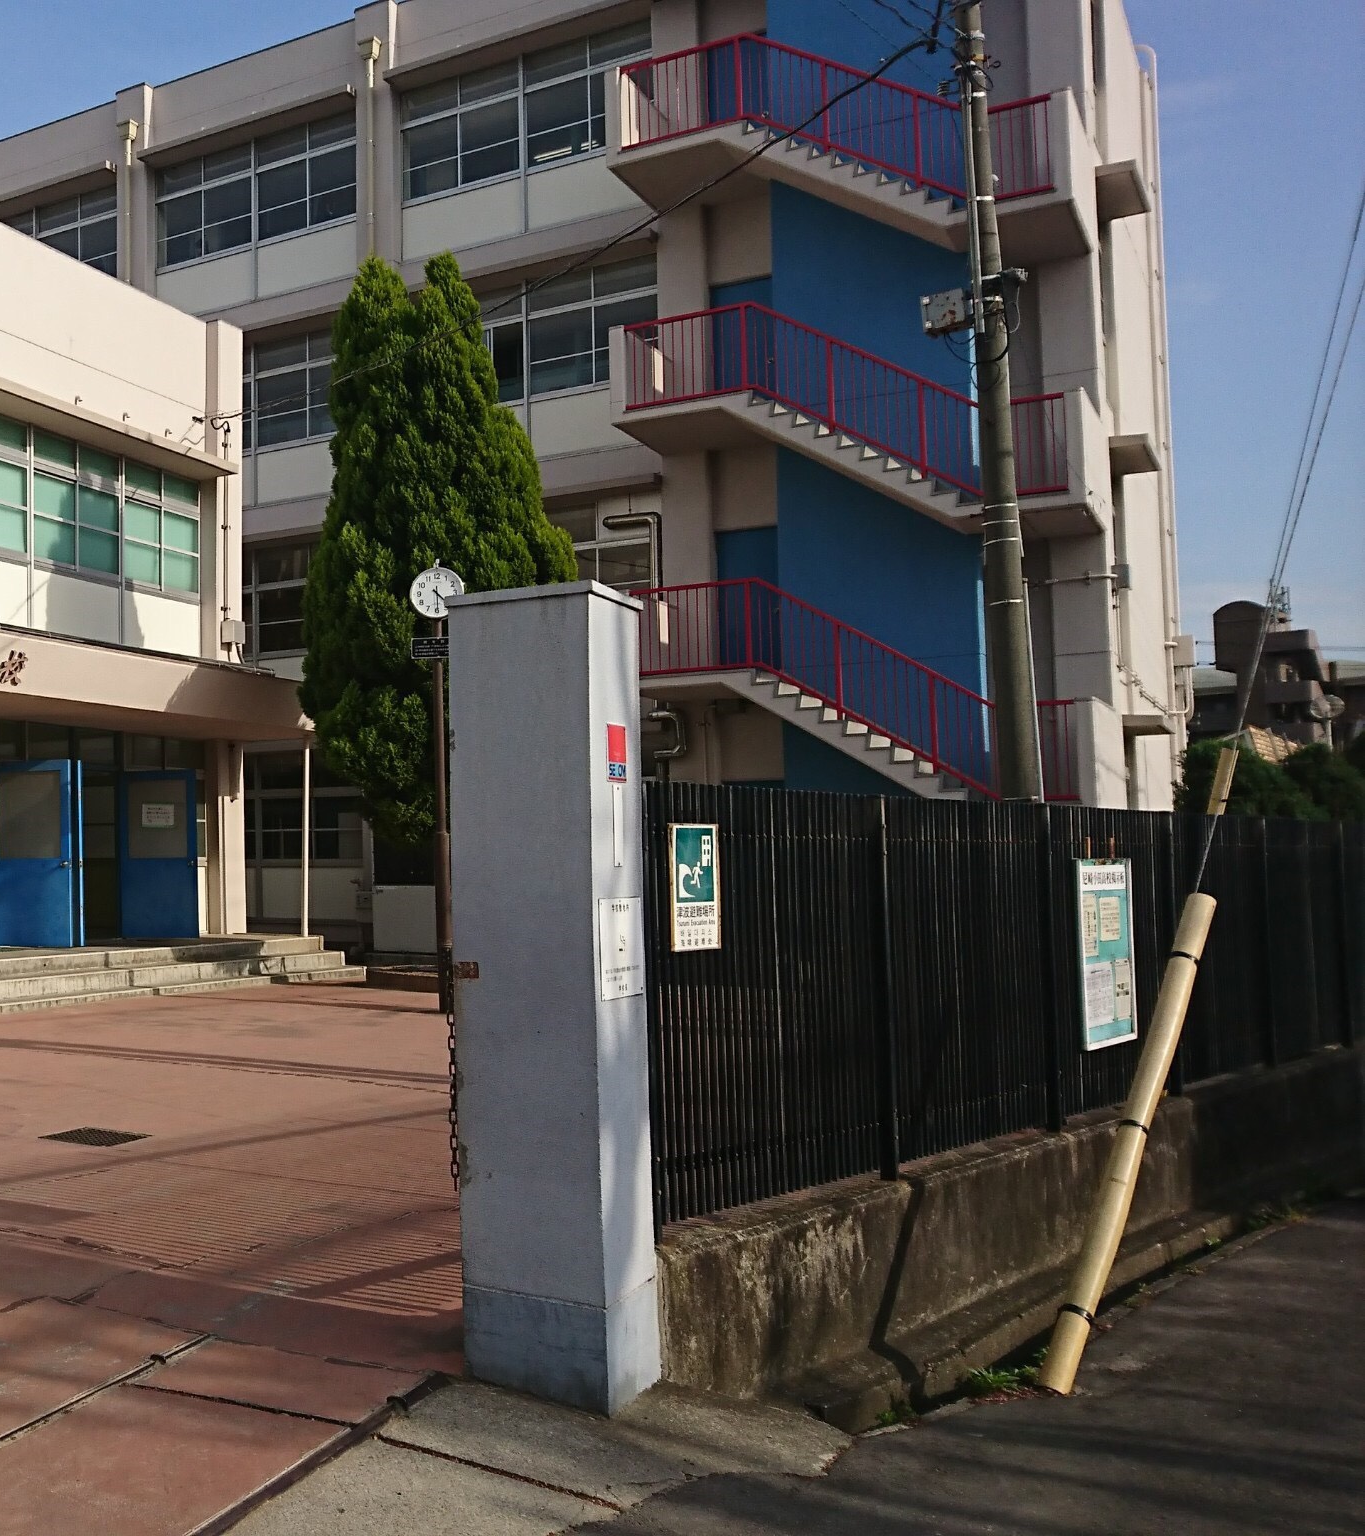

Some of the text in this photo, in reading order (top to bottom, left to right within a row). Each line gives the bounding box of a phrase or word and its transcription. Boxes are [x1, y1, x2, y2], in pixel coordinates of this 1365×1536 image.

[608, 763, 627, 778] SEOM
[676, 904, 715, 918] 津波避難場所
